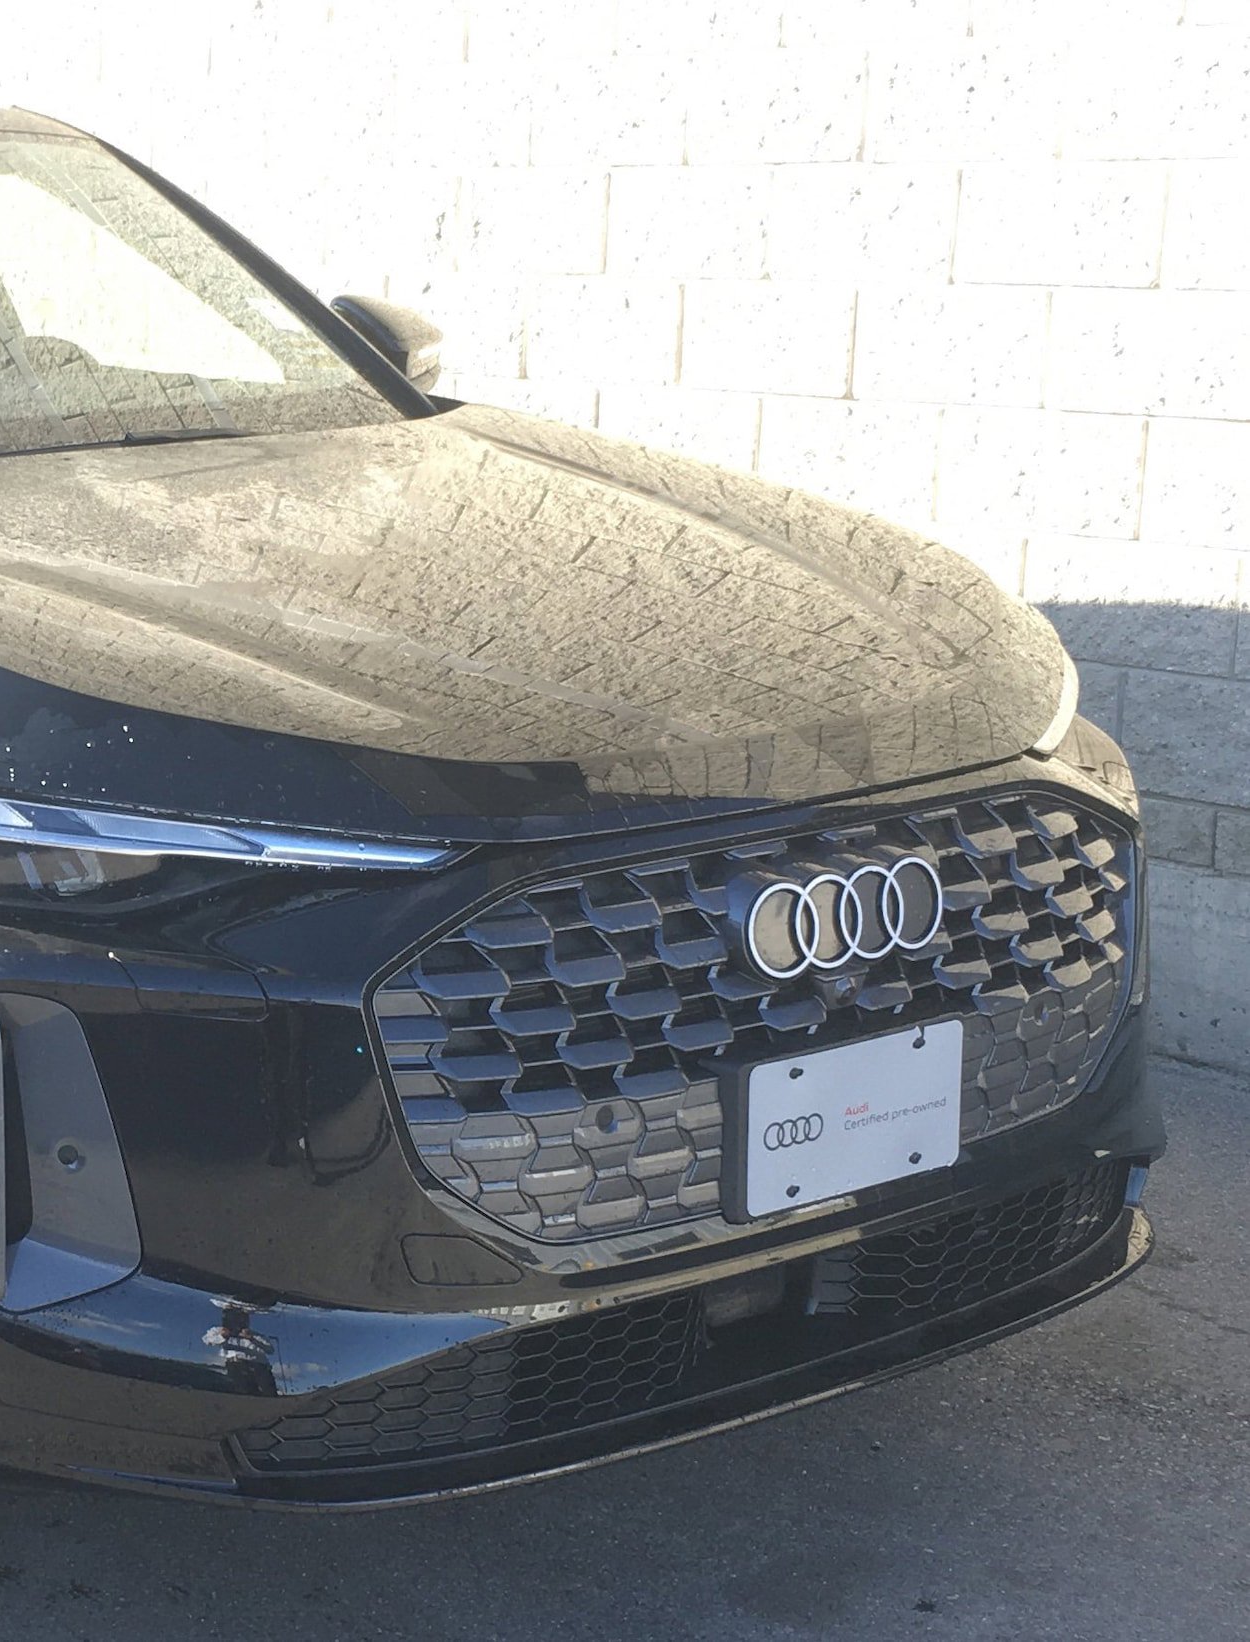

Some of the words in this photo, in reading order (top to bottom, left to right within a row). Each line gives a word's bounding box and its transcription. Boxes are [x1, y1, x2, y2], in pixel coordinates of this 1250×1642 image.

[844, 1111, 889, 1130] Certified
[891, 1097, 947, 1119] pre-owned
[845, 1102, 869, 1116] Audi
